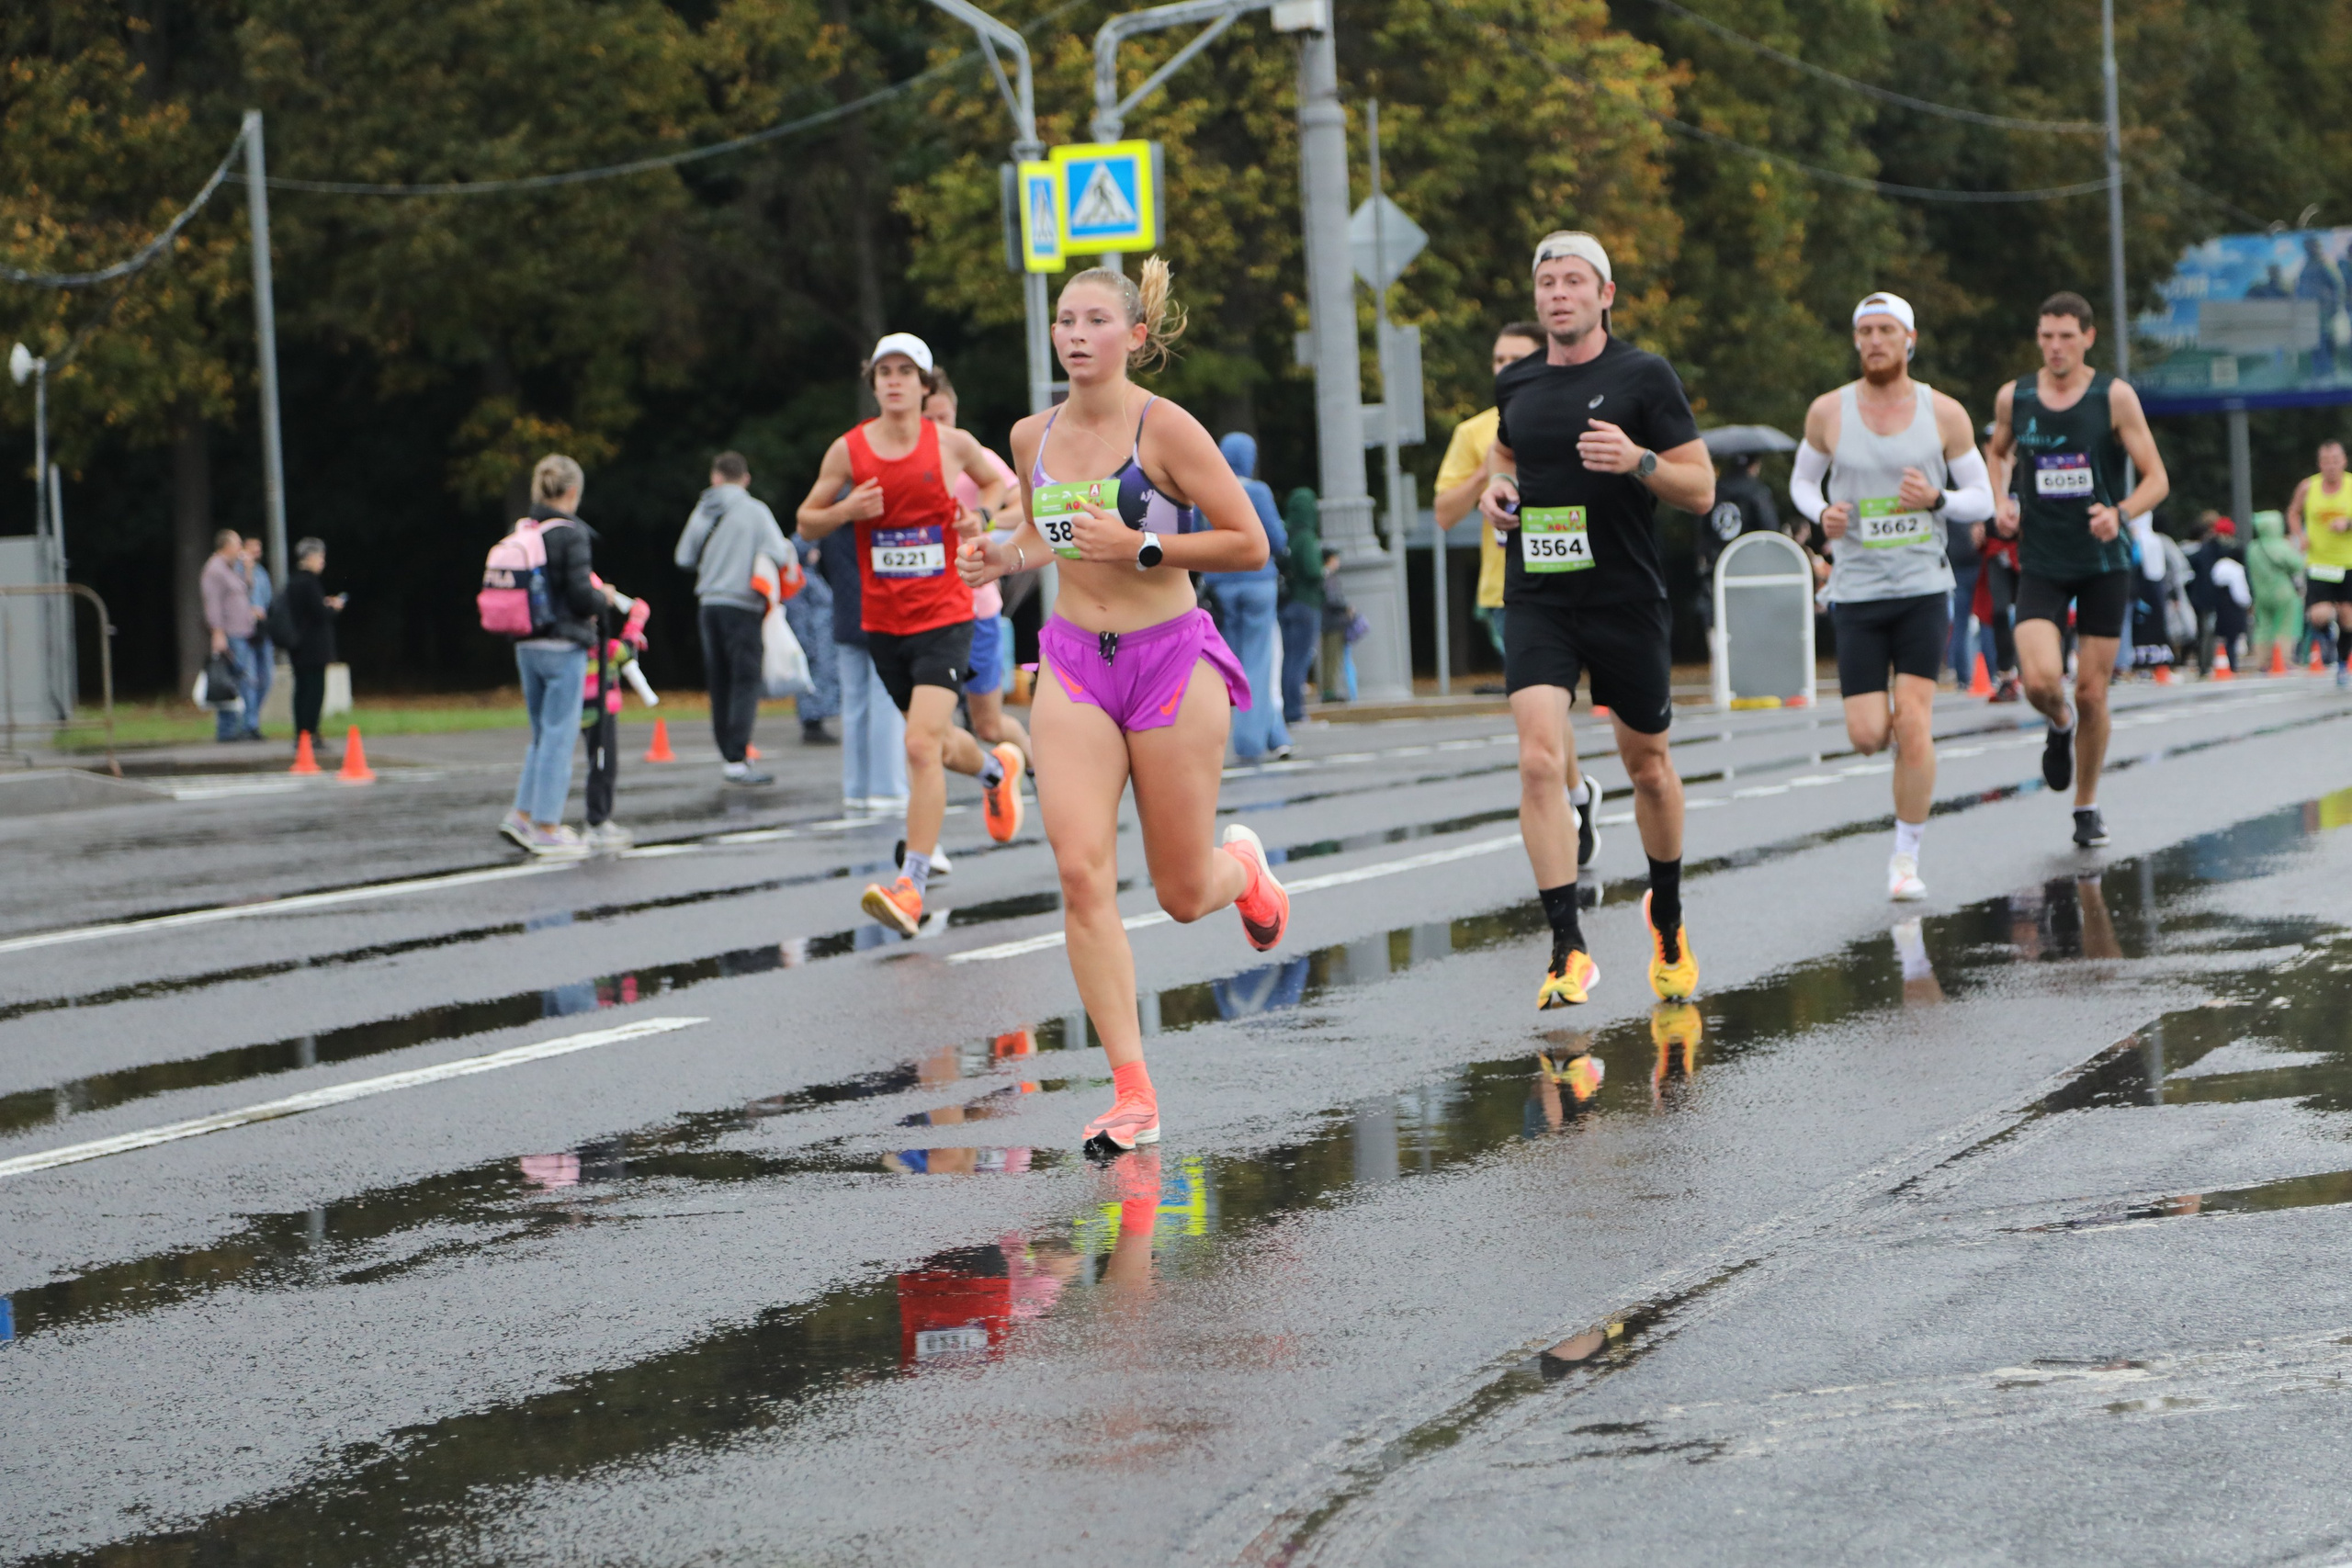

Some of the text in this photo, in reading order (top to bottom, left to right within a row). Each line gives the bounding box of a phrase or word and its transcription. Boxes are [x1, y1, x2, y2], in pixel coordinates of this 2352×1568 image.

[1046, 521, 1074, 543] 38
[1869, 517, 1917, 536] 3662
[1530, 538, 1584, 557] 3564
[883, 551, 926, 567] 6221
